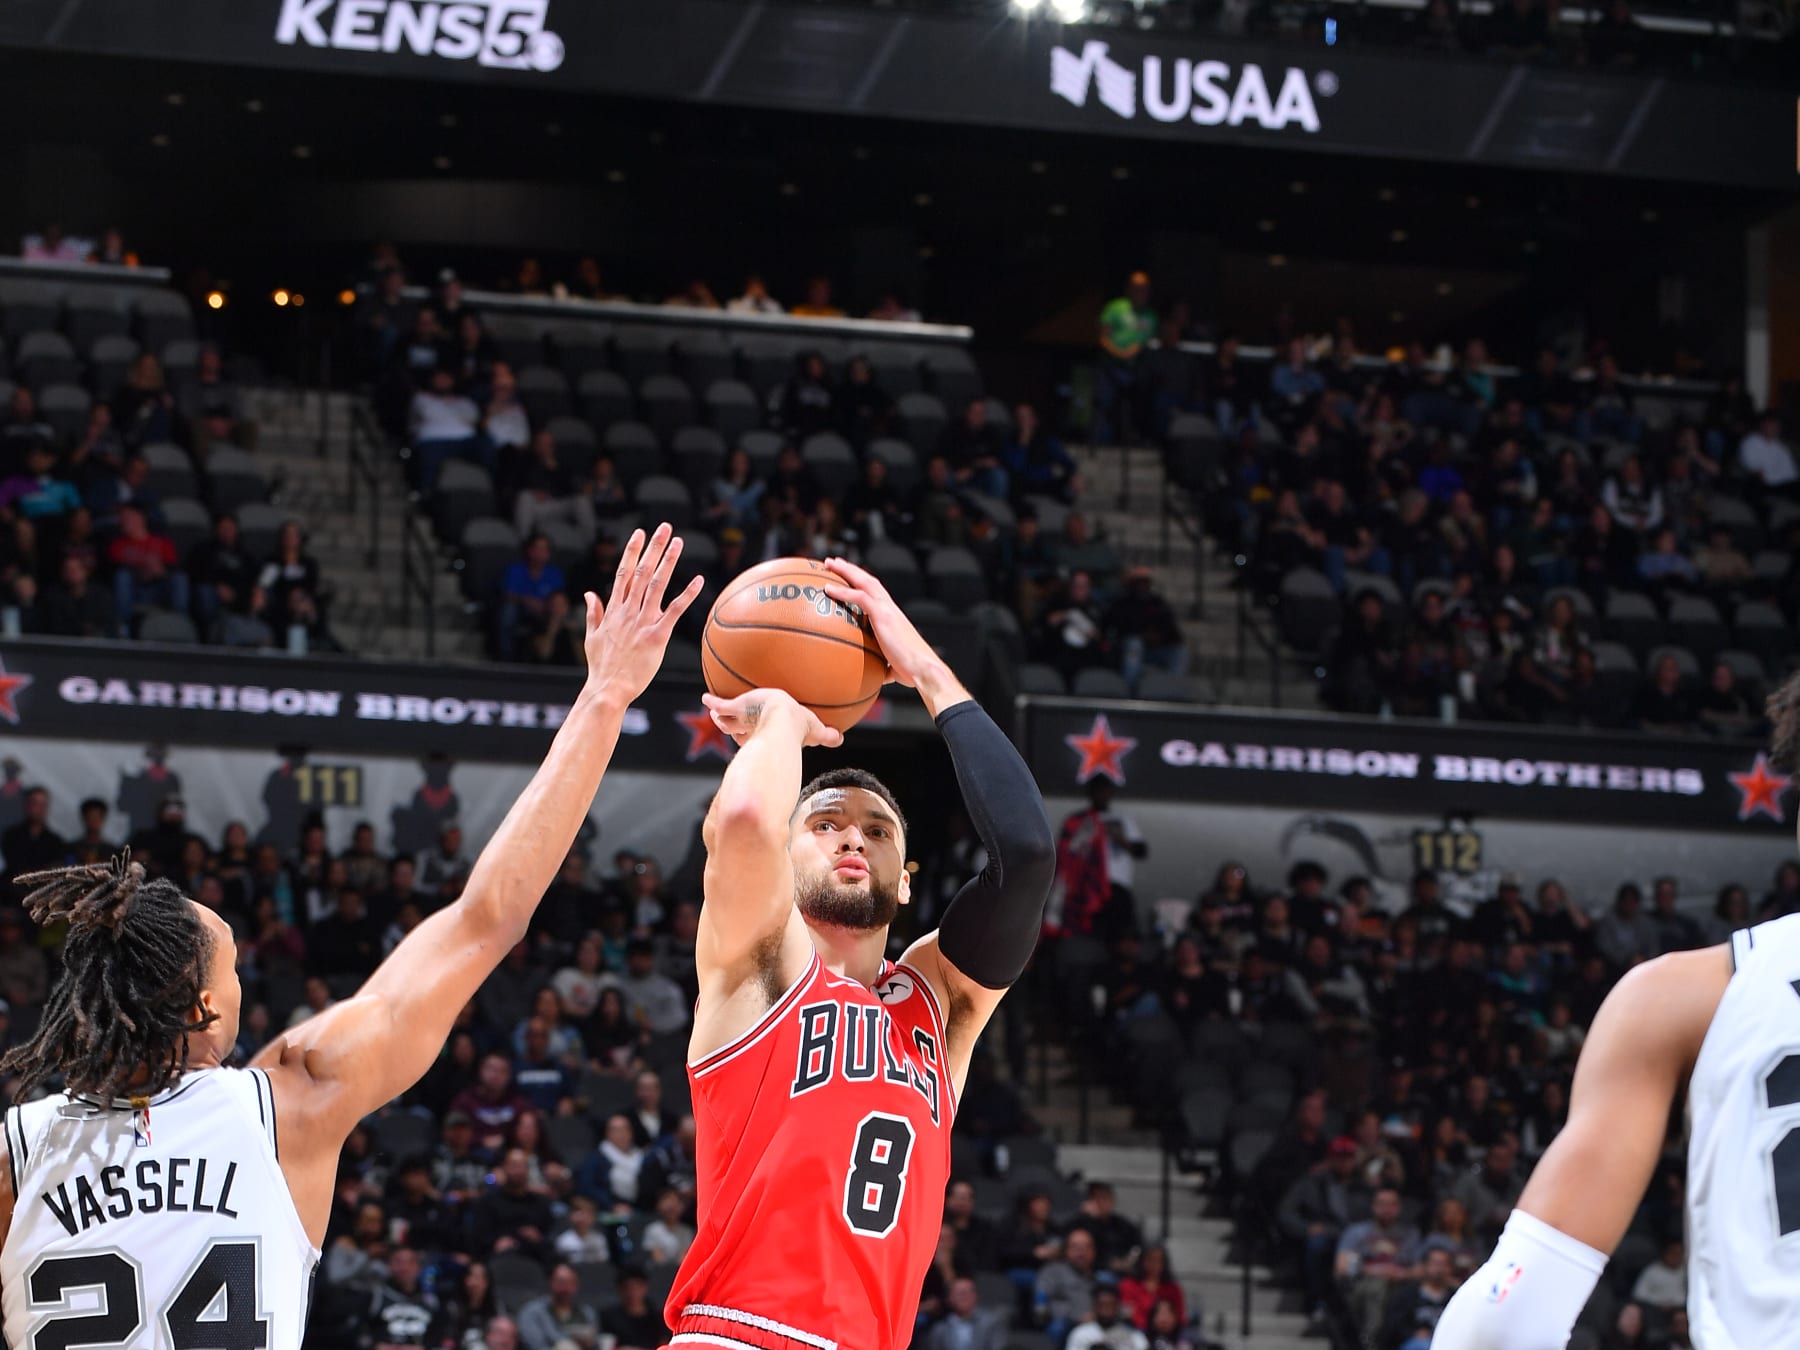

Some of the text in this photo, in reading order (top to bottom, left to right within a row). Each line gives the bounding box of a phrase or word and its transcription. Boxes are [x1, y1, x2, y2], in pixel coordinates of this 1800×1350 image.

[1142, 54, 1322, 133] USAA
[58, 675, 651, 736] GARRISON BROTHES
[294, 766, 354, 806] 111
[1160, 739, 1704, 795] GARRISON BROTHERS
[1416, 831, 1480, 870] 112
[41, 1157, 238, 1237] VASSELL
[842, 1110, 916, 1239] 8
